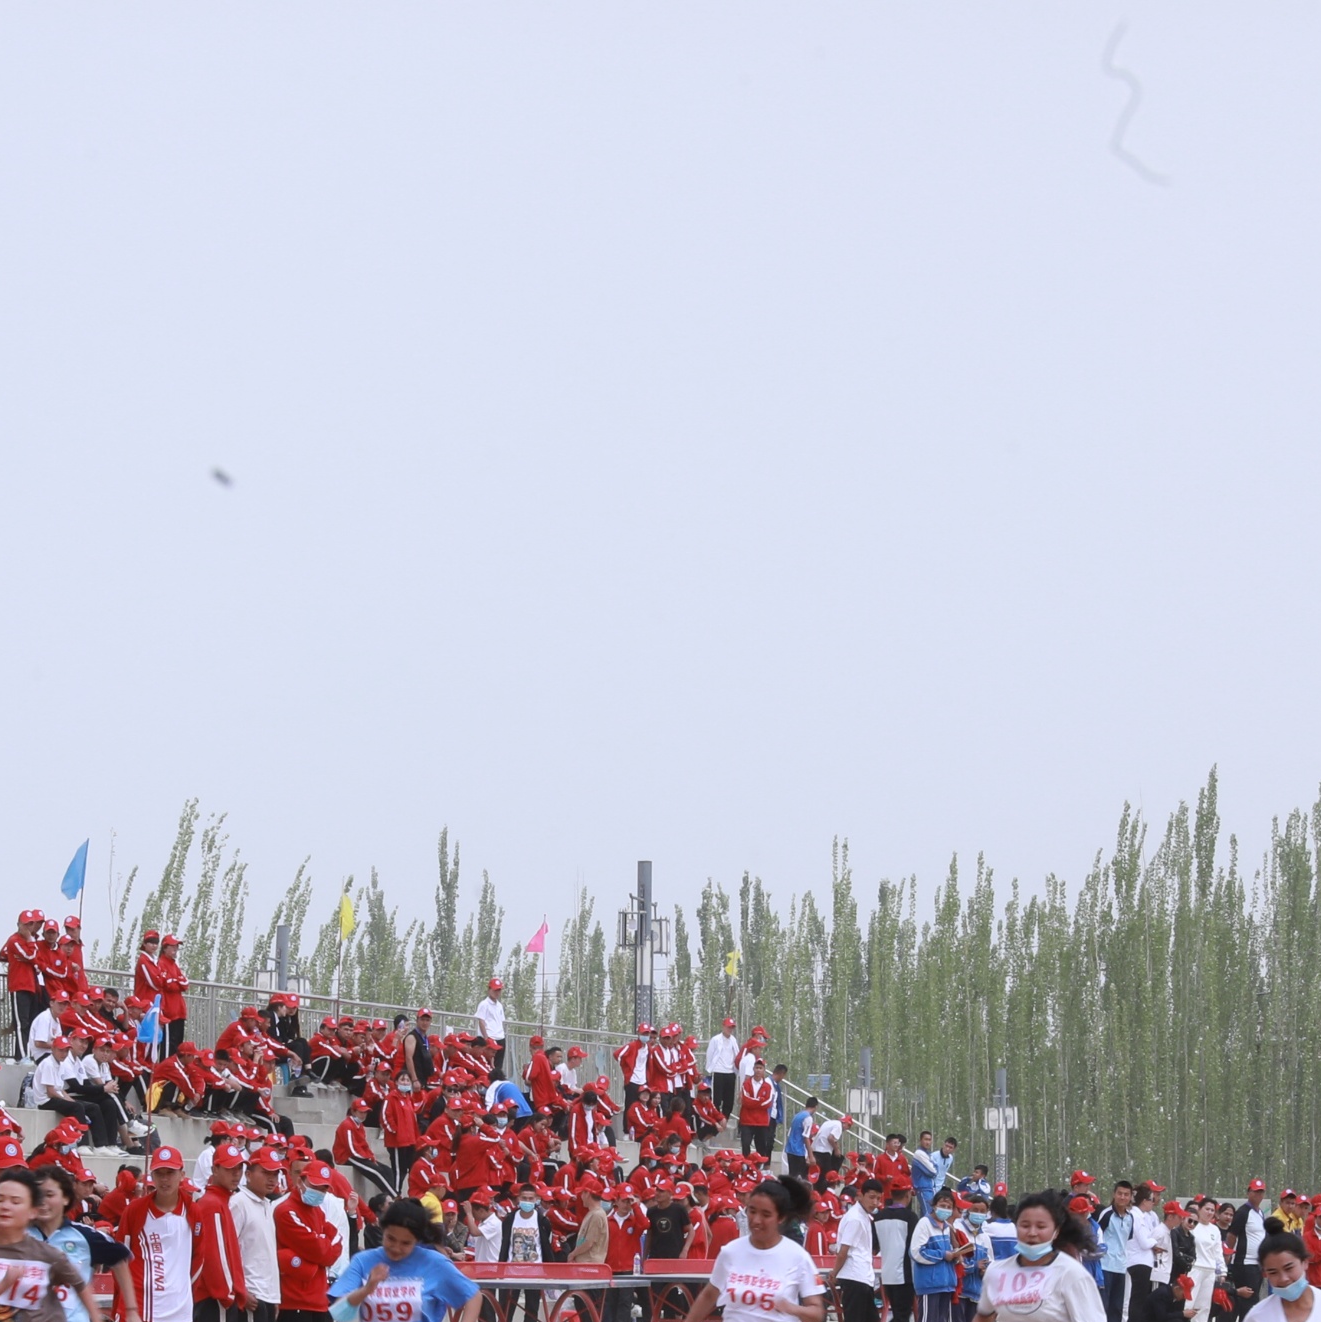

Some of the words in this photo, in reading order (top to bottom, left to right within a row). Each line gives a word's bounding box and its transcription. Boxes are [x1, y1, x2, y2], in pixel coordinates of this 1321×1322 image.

[149, 1232, 163, 1253] 中国
[153, 1255, 165, 1292] CHINA
[726, 1287, 776, 1311] 105
